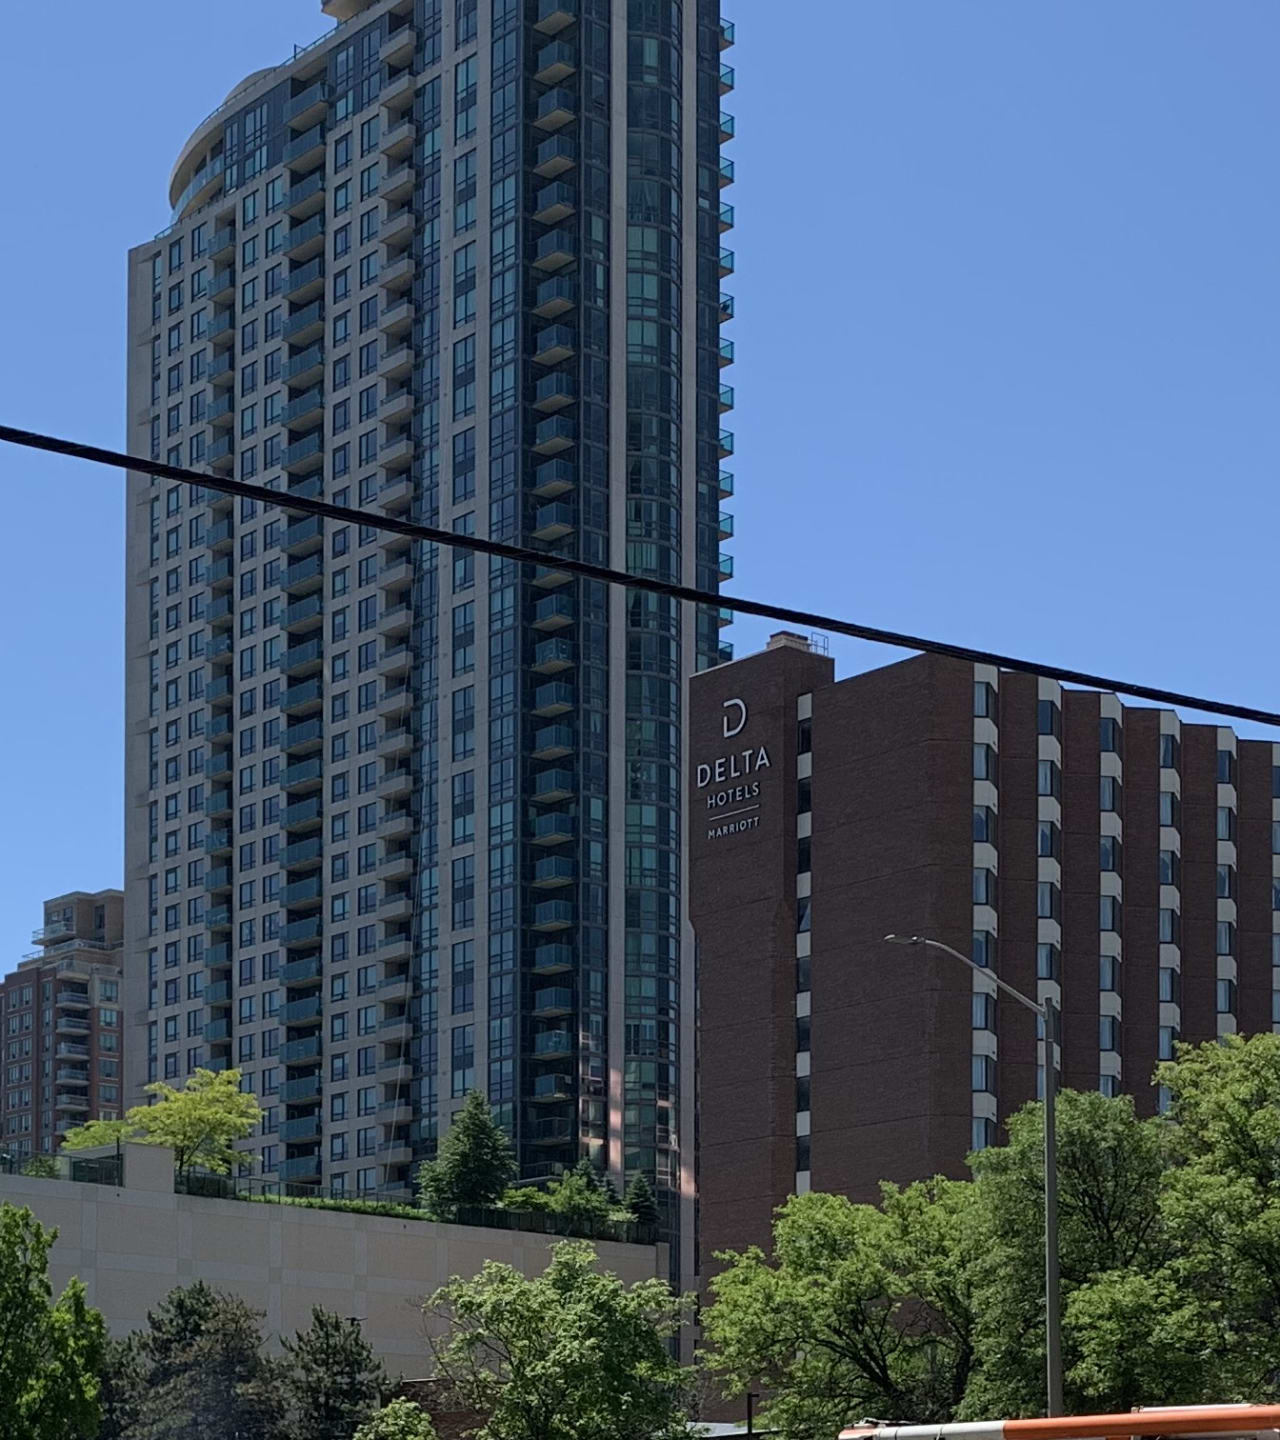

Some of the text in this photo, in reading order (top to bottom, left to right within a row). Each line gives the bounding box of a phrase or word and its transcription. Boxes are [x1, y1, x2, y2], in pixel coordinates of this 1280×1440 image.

[697, 746, 770, 787] DELTA
[707, 782, 760, 808] HOTELS
[707, 817, 760, 839] MARRIOTT
